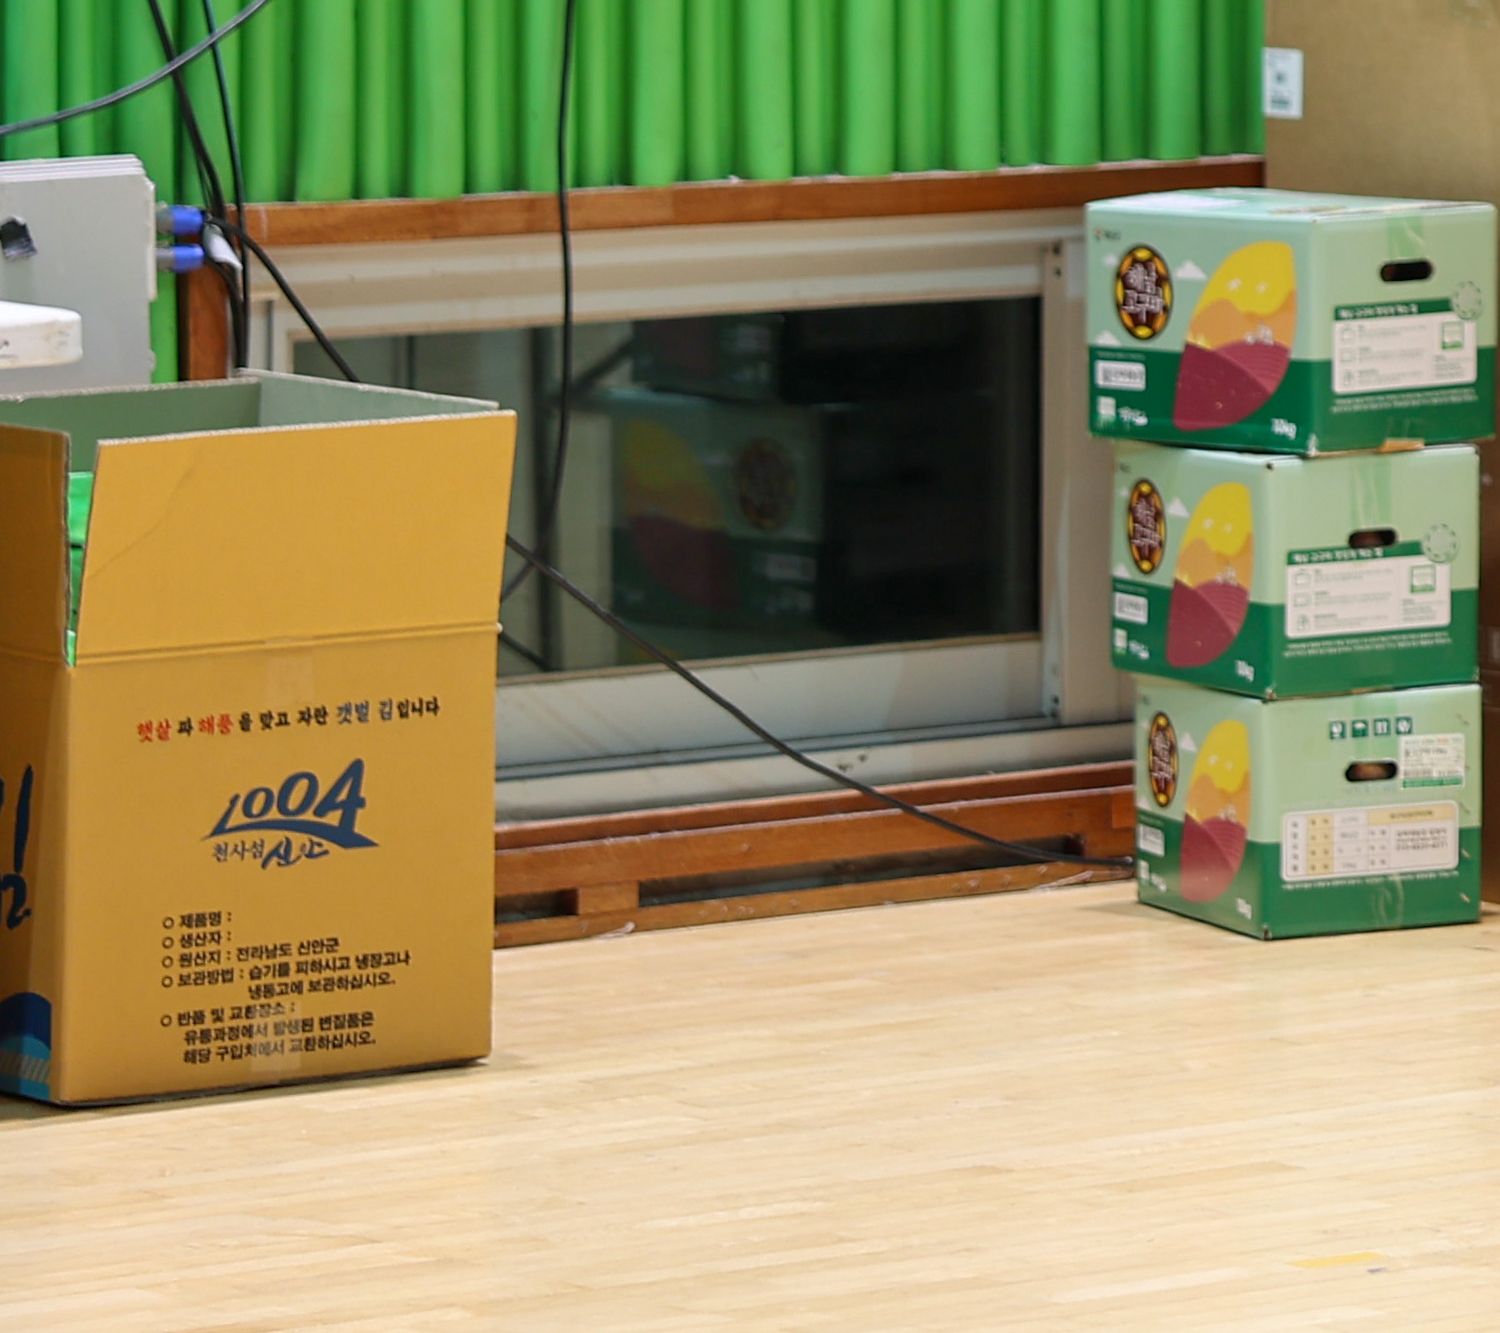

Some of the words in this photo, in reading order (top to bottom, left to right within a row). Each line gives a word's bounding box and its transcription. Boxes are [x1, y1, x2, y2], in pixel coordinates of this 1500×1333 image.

[137, 716, 172, 743] 햇살
[198, 713, 235, 735] 해풍
[259, 709, 291, 732] 맞고
[297, 705, 328, 727] 자란
[336, 700, 370, 725] 갯벌
[213, 838, 265, 863] 천사섬
[178, 910, 222, 929] 제품명
[178, 949, 222, 968] 원산지
[236, 941, 293, 963] 전라남도
[297, 936, 341, 956] 신안군
[179, 930, 222, 949] 생산자
[177, 967, 235, 988] 보관방법
[248, 959, 291, 981] 습기를
[295, 954, 352, 975] 피하시고
[354, 948, 412, 971] 냉장고나
[248, 979, 304, 1000] 냉동고에
[307, 970, 396, 994] 보관하십시오.
[177, 1009, 206, 1027] 반품
[210, 1006, 225, 1024] 및
[229, 1001, 287, 1022] 교환장소
[184, 1023, 269, 1046] 유통과정에서
[273, 1016, 315, 1037] 발생된
[318, 1010, 375, 1032] 변질품은
[183, 1045, 212, 1065] 해당
[215, 1040, 286, 1062] 구입처에서
[288, 1030, 377, 1054] 교환하십시오.
